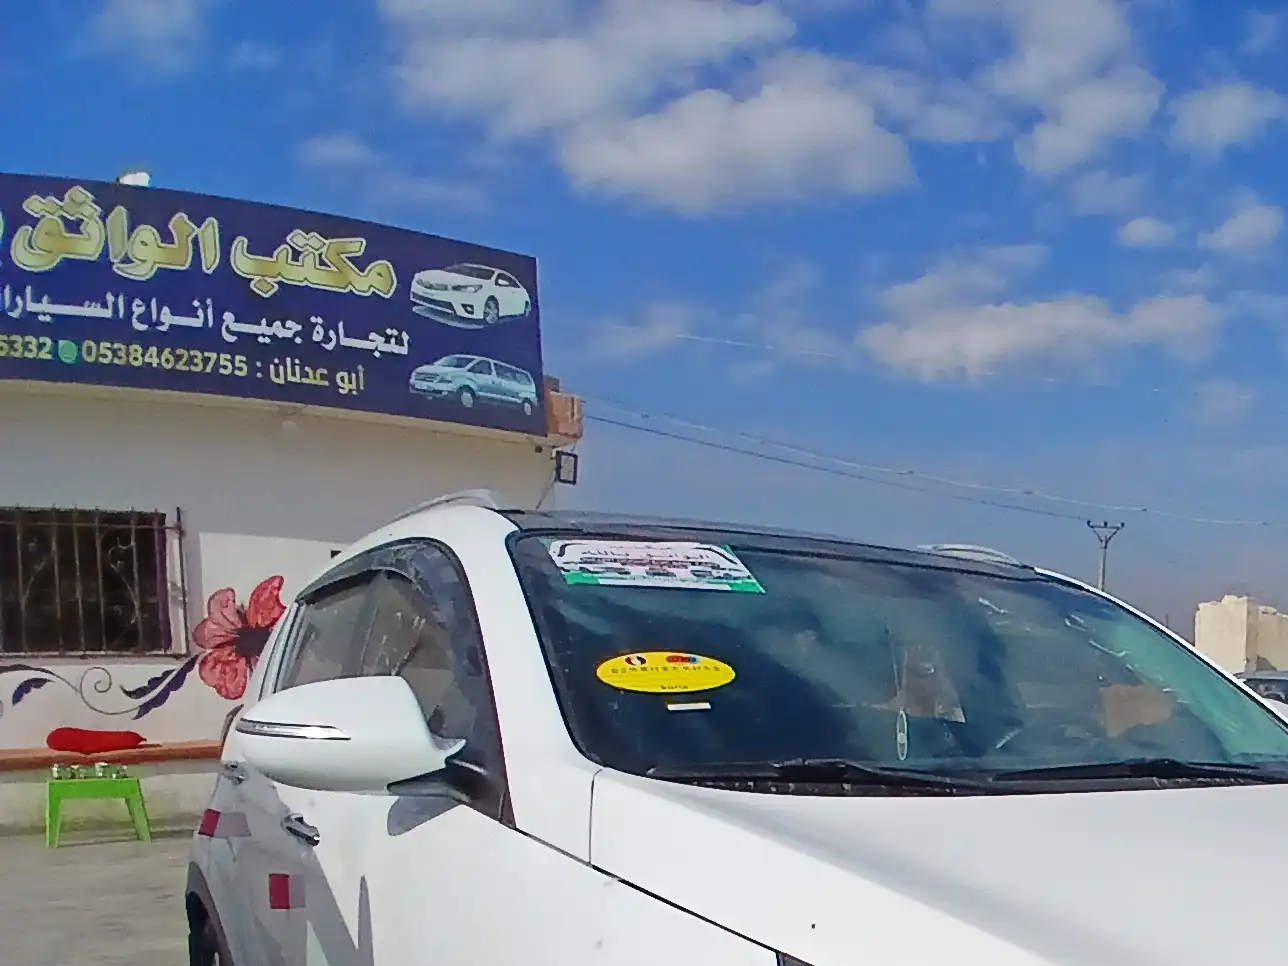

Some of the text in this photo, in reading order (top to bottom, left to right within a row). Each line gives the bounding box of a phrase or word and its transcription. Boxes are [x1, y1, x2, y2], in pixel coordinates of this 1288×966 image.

[10, 185, 220, 281] الواثق
[230, 229, 398, 298] مكتب
[4, 284, 410, 359] لتجارة جميع أنواع السيارا
[82, 339, 249, 378] 05384623755
[269, 356, 330, 385] عدنان
